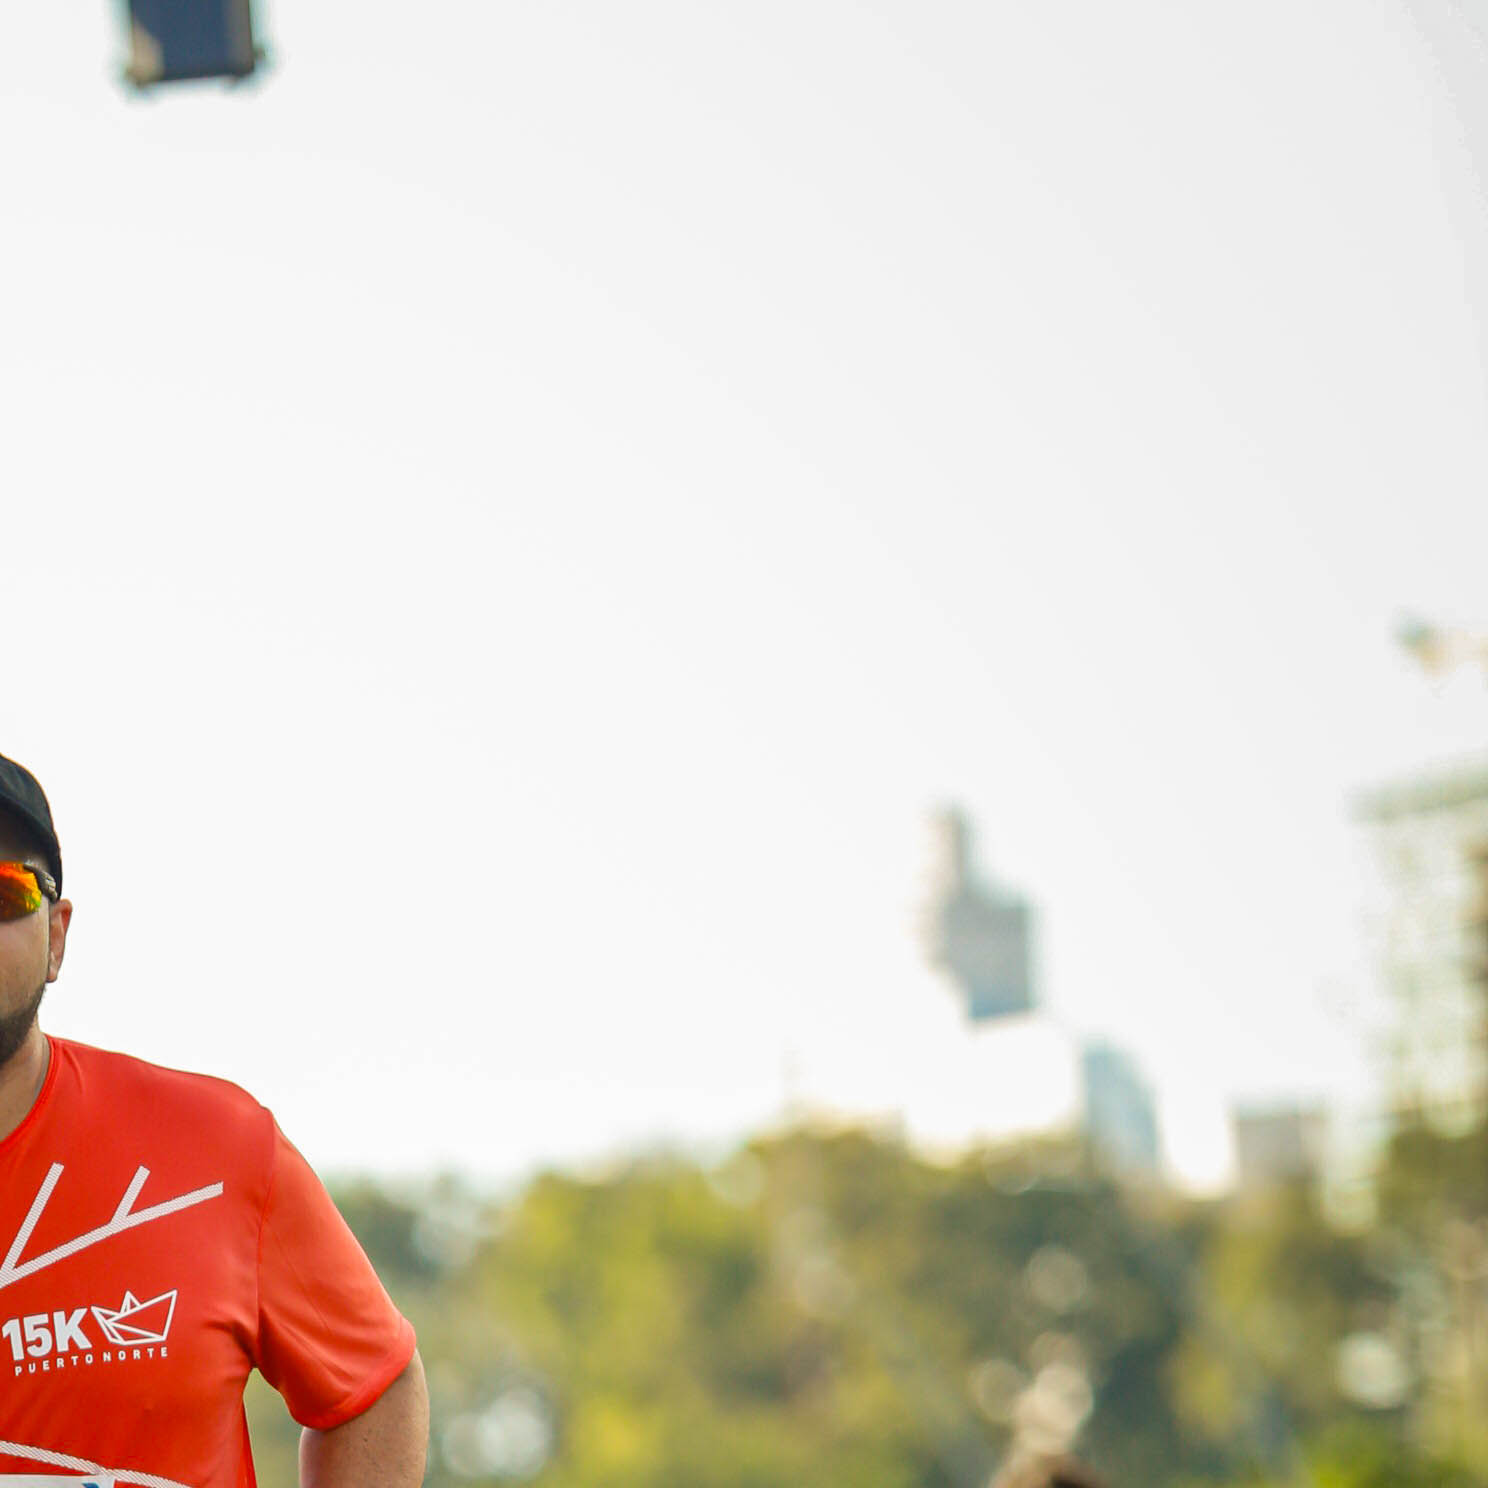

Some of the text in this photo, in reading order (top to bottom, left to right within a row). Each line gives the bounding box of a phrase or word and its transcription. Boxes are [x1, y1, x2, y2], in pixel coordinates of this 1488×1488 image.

[1, 1308, 92, 1361] 15K
[14, 1346, 168, 1376] PUERTO NORTE
